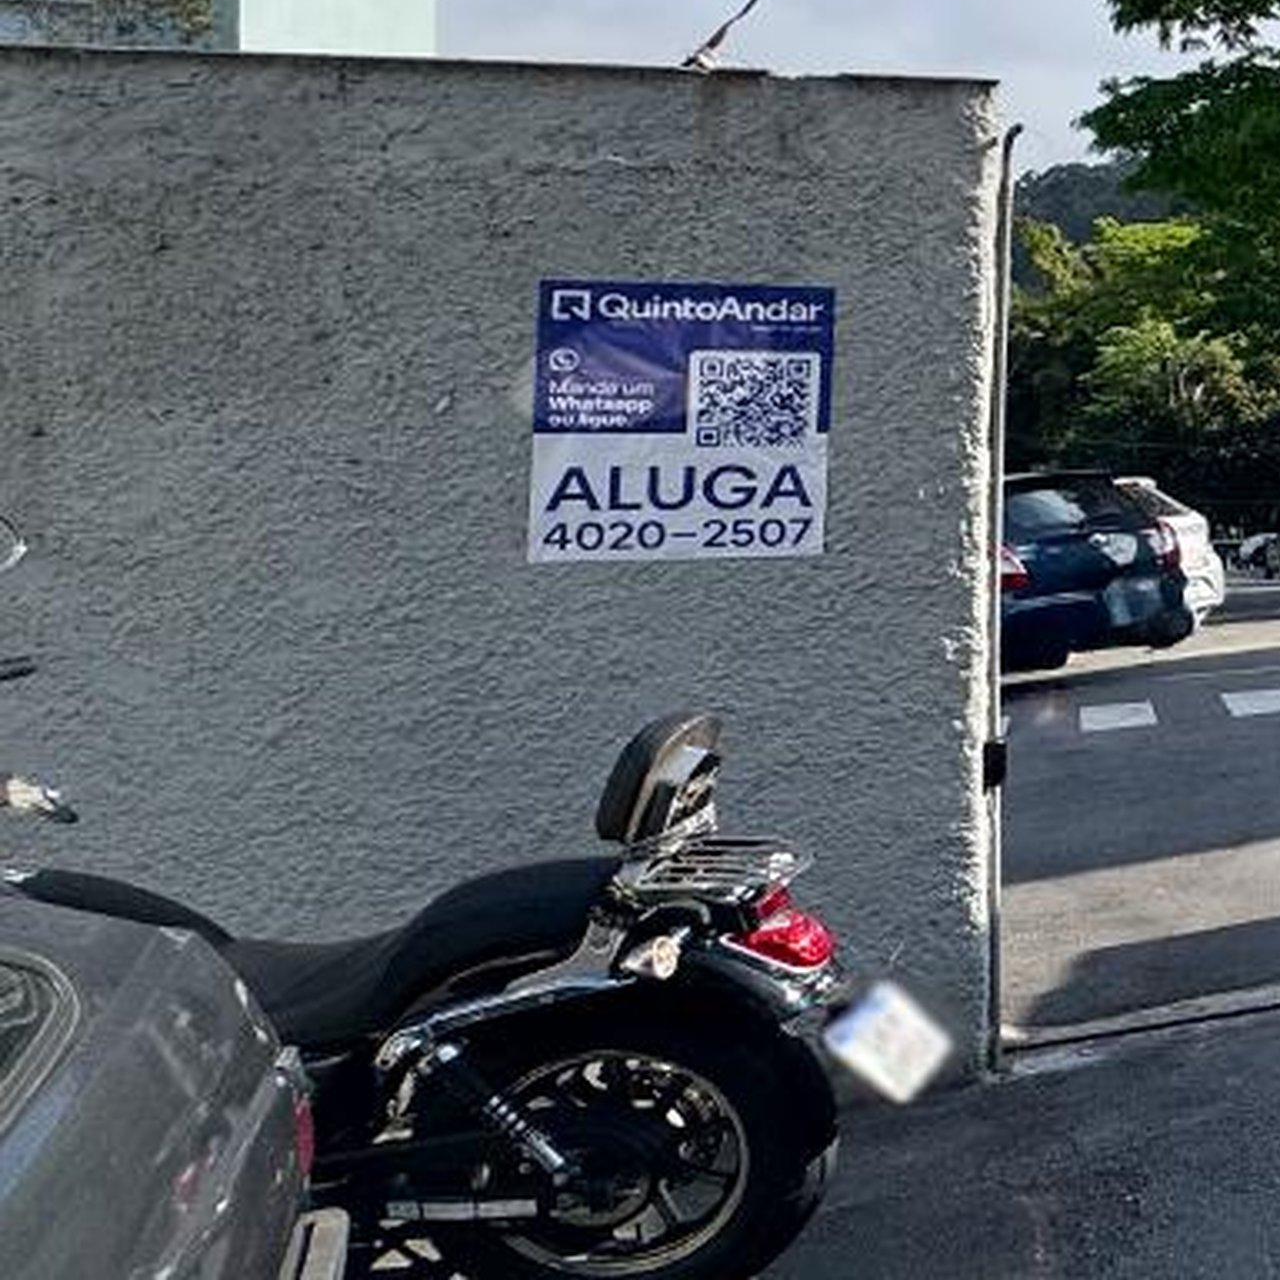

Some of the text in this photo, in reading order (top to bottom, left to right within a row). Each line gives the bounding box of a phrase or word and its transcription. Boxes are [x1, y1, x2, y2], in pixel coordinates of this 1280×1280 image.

[599, 292, 825, 322] QuintoAndar
[622, 383, 654, 396] um
[545, 464, 814, 512] ALUGA
[541, 517, 815, 551] 4020-2507
